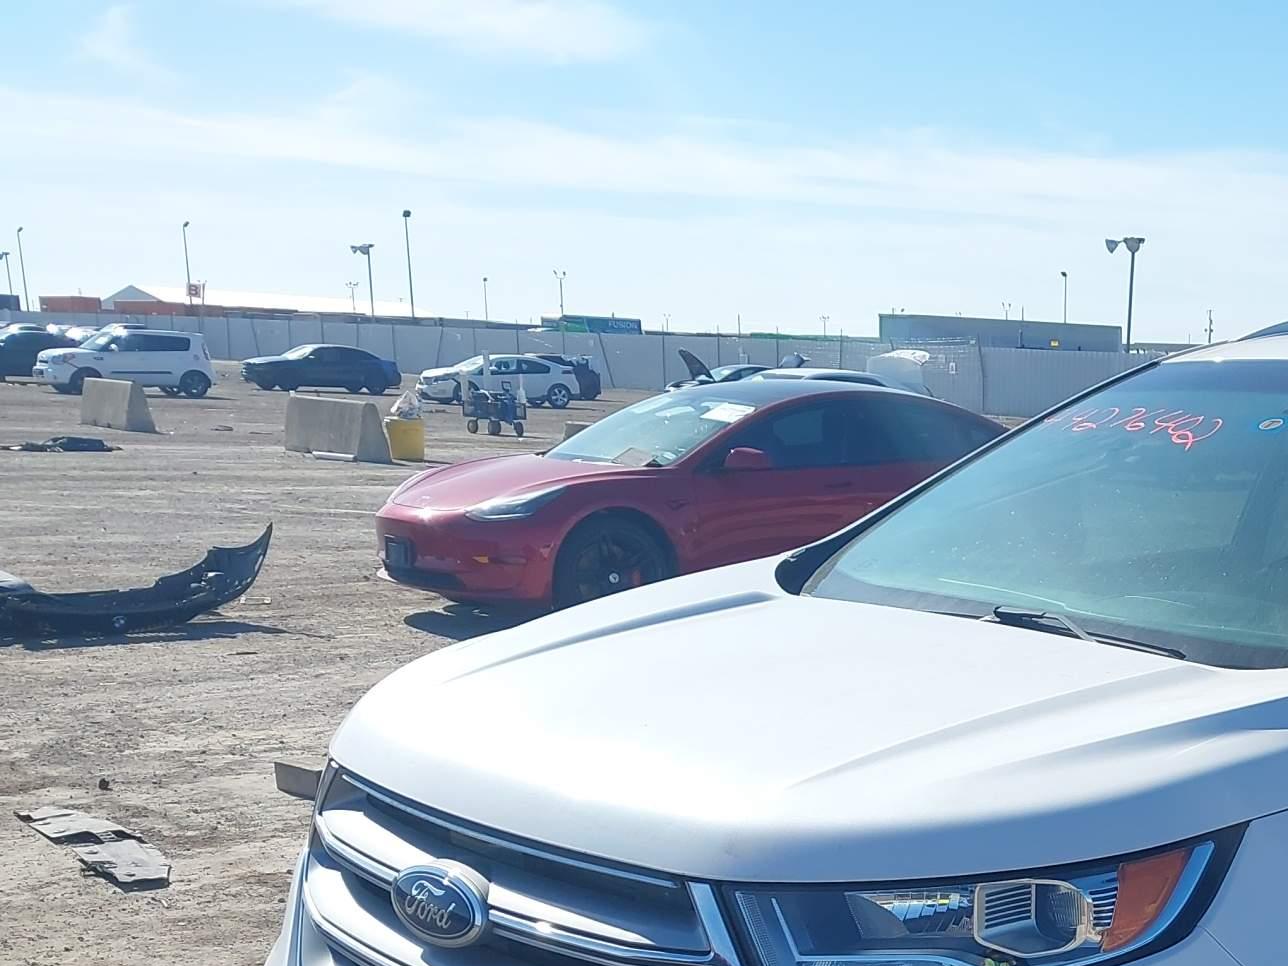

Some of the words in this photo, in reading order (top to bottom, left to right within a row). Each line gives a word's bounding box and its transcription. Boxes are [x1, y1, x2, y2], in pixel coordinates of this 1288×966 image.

[188, 284, 198, 296] B
[608, 319, 638, 329] FUSION
[404, 880, 456, 929] Ford
